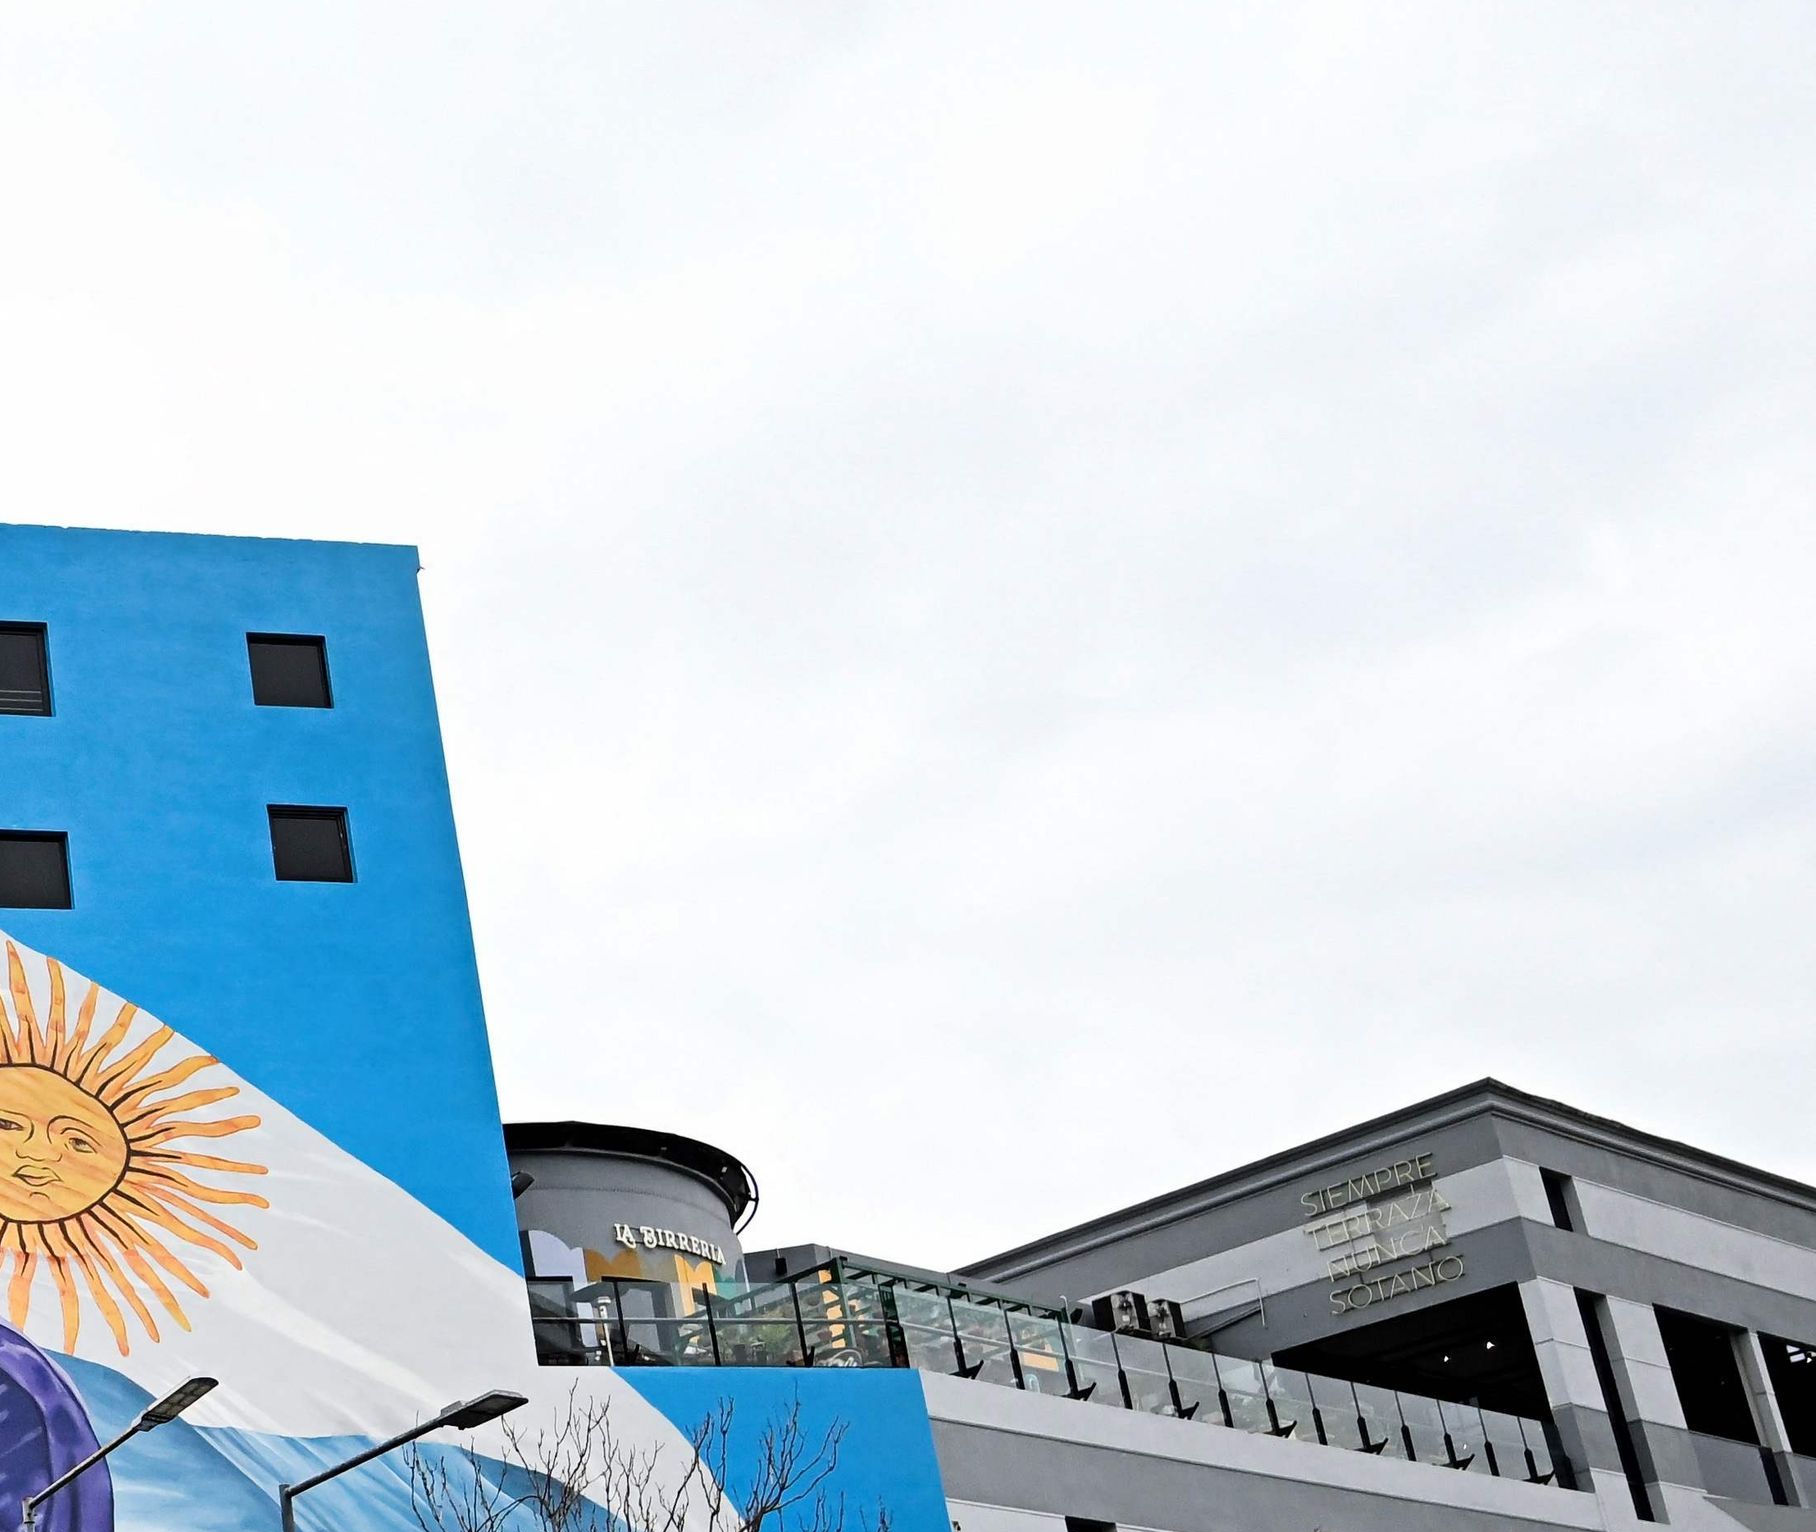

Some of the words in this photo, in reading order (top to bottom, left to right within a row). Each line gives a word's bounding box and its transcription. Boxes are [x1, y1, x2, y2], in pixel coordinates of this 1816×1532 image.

[1301, 1152, 1437, 1217] SIEMPRE
[614, 1223, 636, 1249] LA
[640, 1226, 727, 1265] BIRRERIA
[1304, 1187, 1451, 1251] TERRAZA
[1327, 1226, 1448, 1282] NUNCA
[1330, 1256, 1464, 1315] SOTANO
